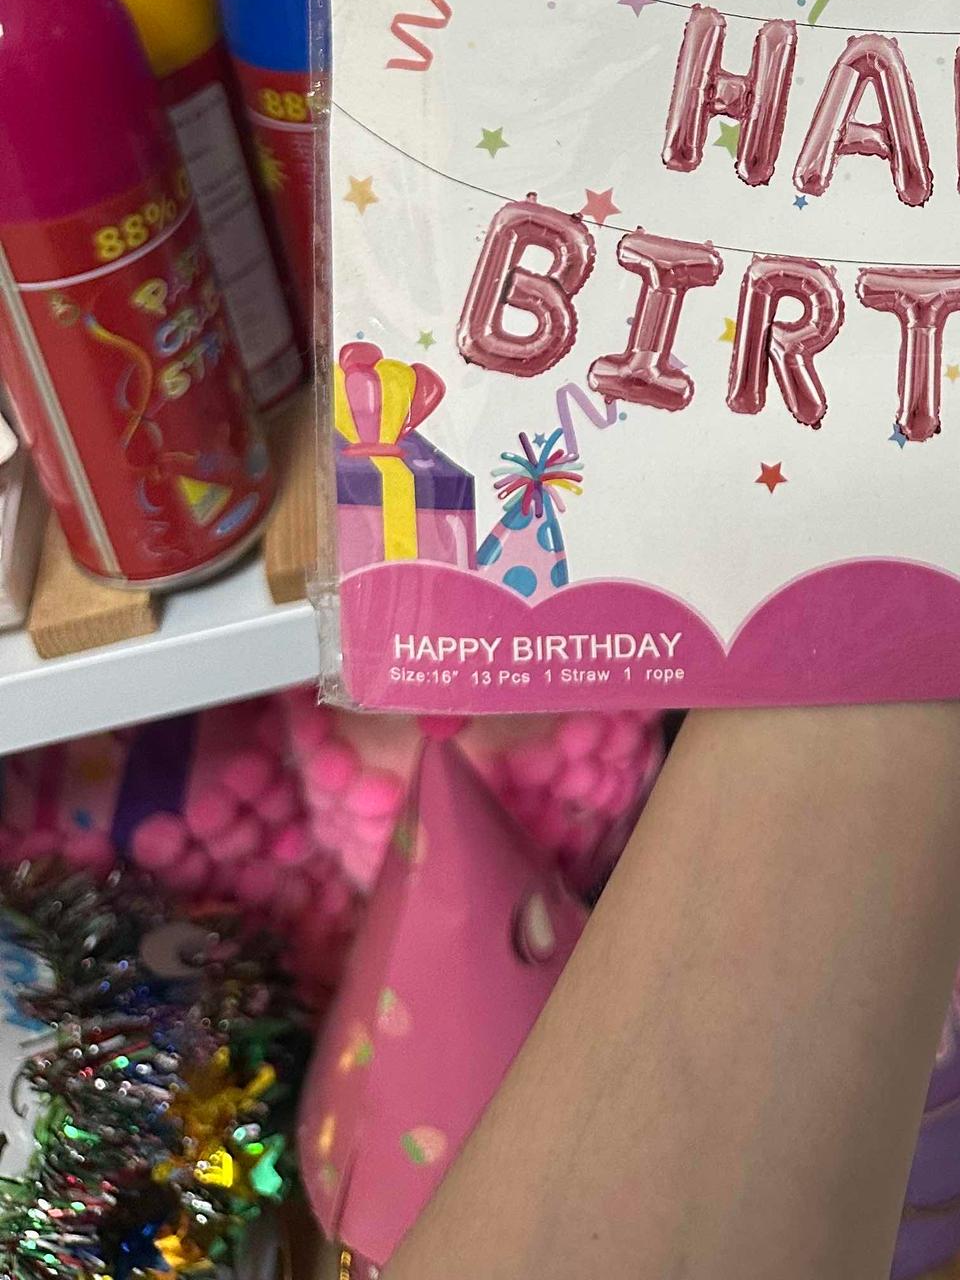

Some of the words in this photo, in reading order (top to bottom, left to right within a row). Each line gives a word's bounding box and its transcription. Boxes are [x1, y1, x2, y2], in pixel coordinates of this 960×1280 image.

[394, 633, 502, 663] HAPPY
[513, 632, 682, 662] BIRTHDAY
[472, 670, 492, 685] 13
[499, 670, 530, 685] Pcs
[545, 669, 552, 683] 1
[561, 668, 610, 682] Straw
[624, 667, 631, 681] 1
[646, 668, 685, 684] rope
